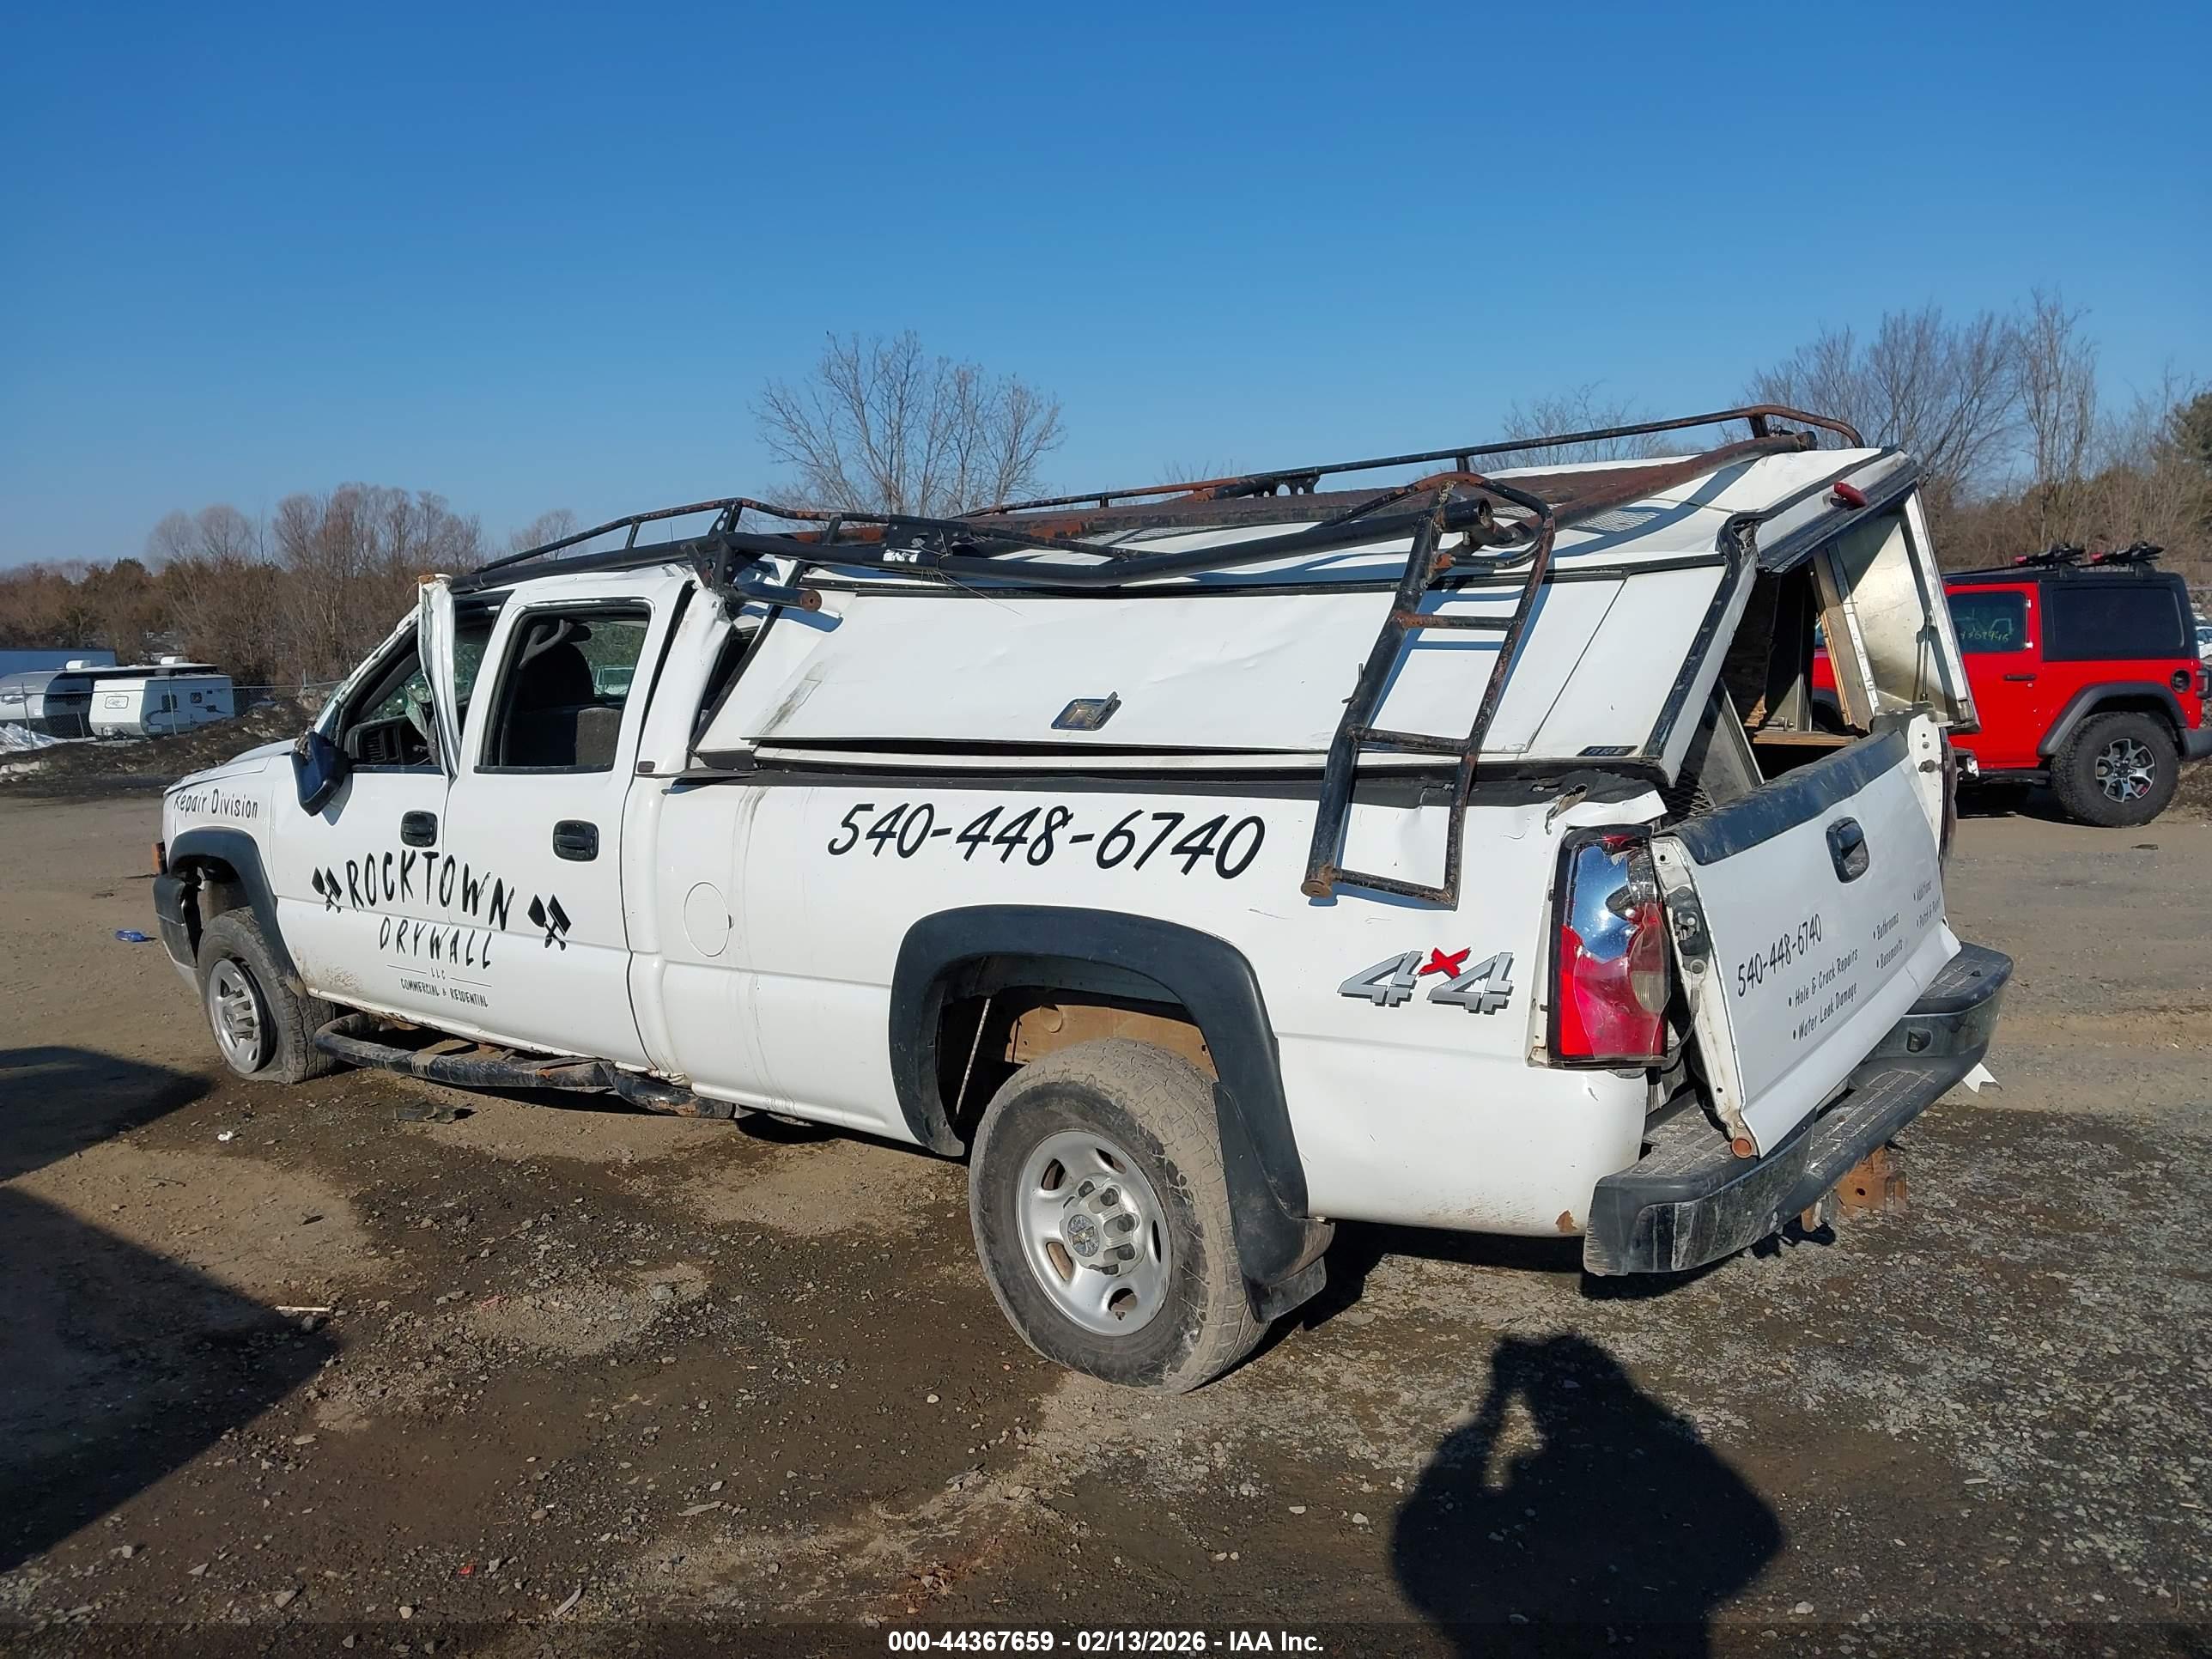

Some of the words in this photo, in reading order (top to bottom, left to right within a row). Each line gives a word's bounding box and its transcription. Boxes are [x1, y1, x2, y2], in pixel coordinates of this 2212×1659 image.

[173, 787, 207, 818] Repair
[211, 788, 258, 819] Division
[827, 802, 1266, 880] 540-448-6740
[345, 849, 515, 932] ROCKTOWN
[380, 916, 492, 969] DRYWALL
[1738, 913, 1822, 997] 540-448-6740
[400, 978, 441, 997] COMMERCIAL
[430, 967, 446, 980] LLC
[1796, 985, 1809, 1008] Hole
[1811, 977, 1817, 995] &
[1819, 962, 1836, 989] Crack
[1837, 949, 1858, 975] Repairs
[1798, 1015, 1817, 1042] Water
[1820, 997, 1835, 1024] Leak
[1835, 982, 1857, 1010] Damage
